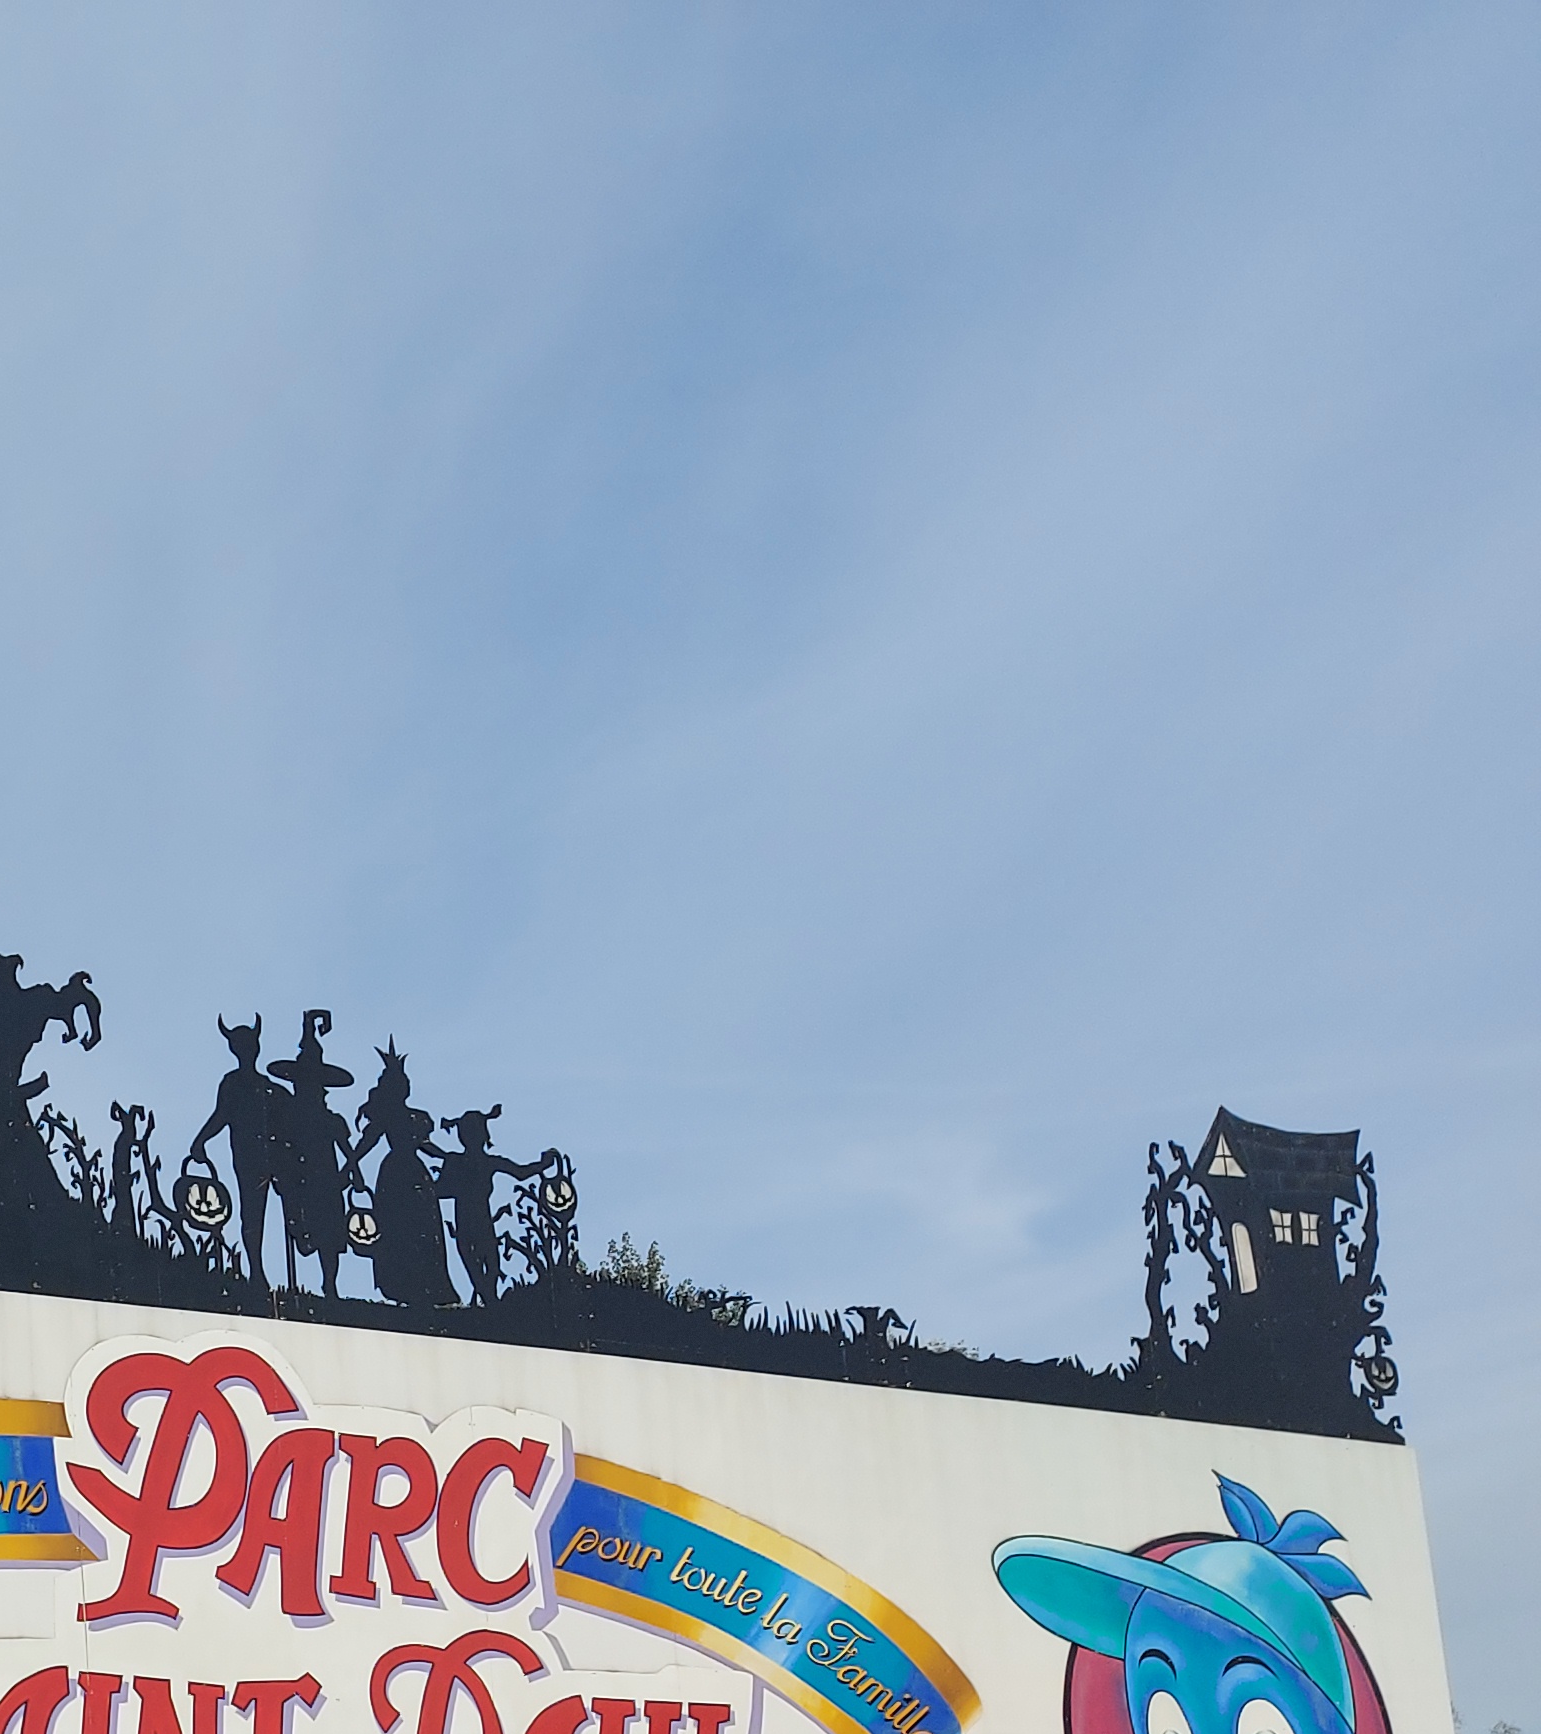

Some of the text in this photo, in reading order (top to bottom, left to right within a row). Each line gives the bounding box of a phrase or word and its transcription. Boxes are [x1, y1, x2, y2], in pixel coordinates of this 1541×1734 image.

[64, 1345, 551, 1624] PARC
[556, 1524, 663, 1570] pour
[669, 1546, 763, 1616] toute
[760, 1593, 804, 1645] la
